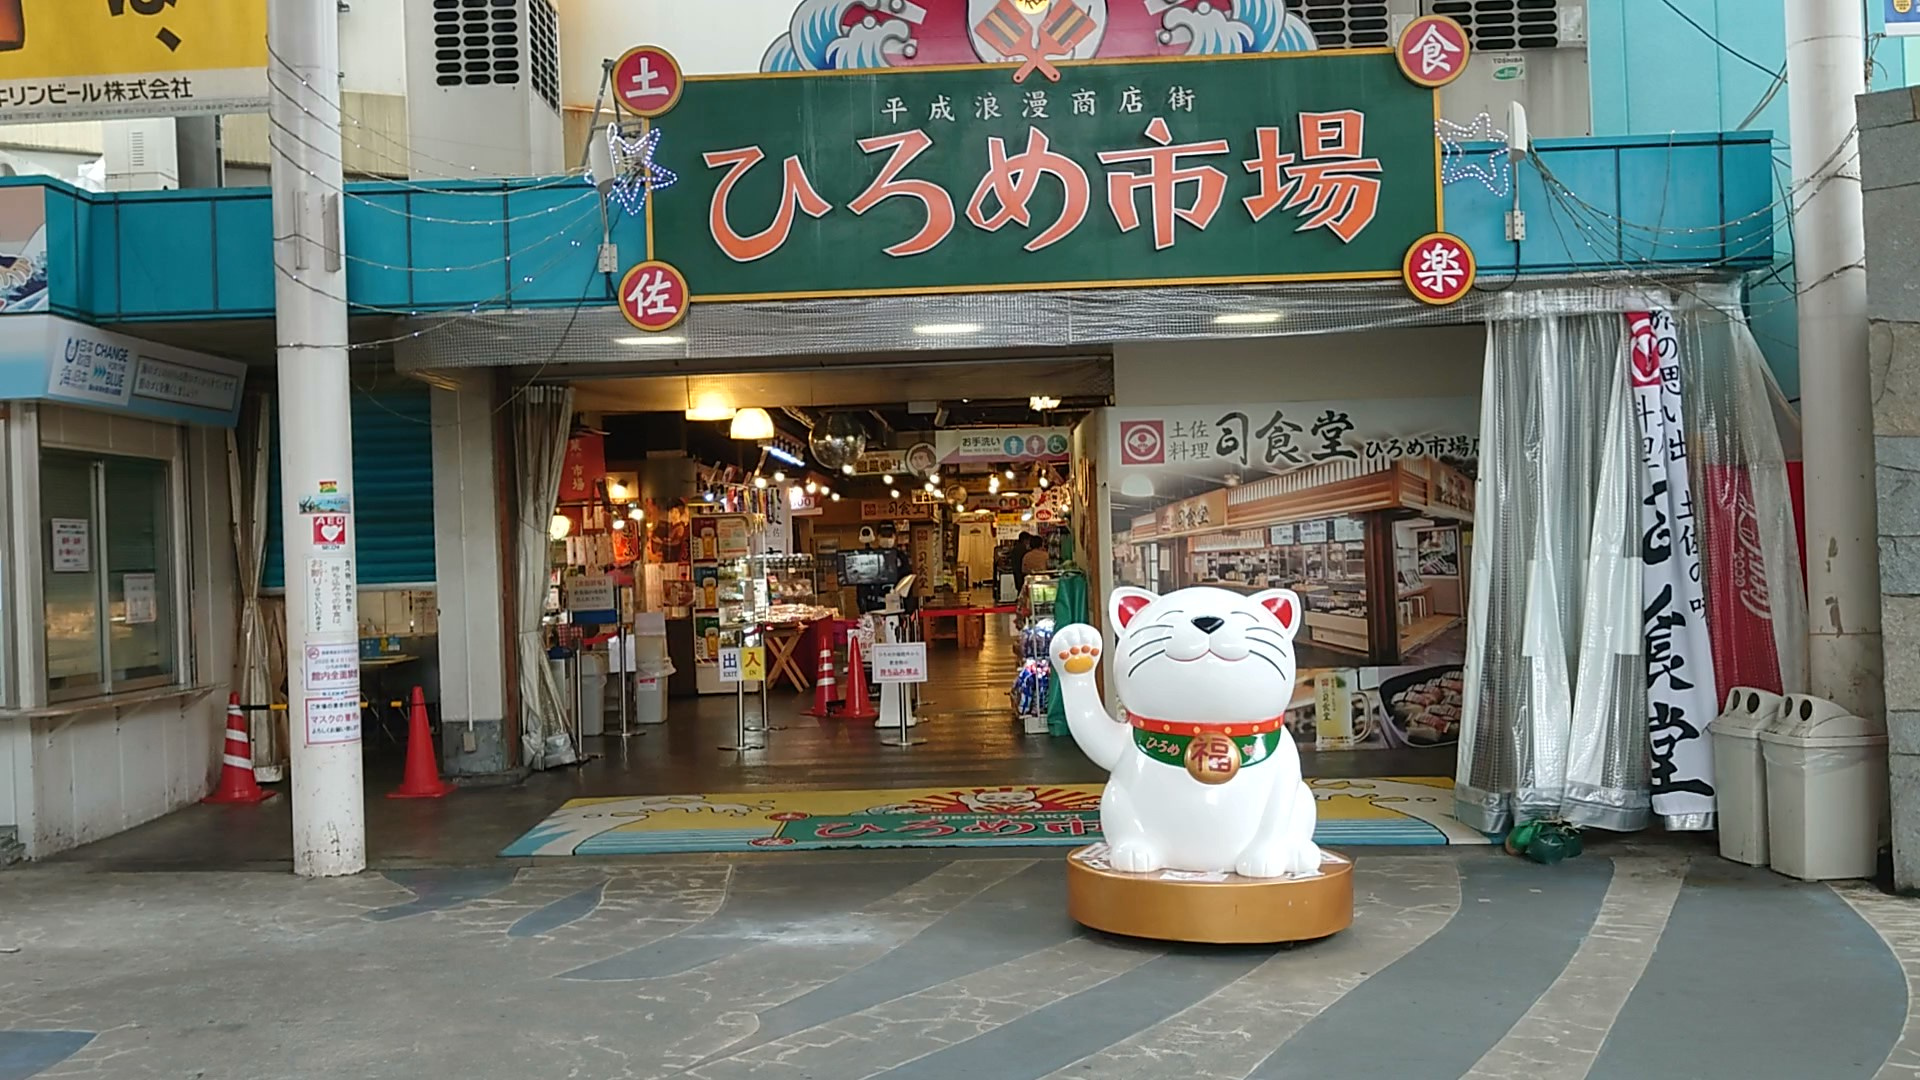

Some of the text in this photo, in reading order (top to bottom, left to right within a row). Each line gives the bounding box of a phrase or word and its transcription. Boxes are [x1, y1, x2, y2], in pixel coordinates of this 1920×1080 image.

[1407, 23, 1461, 75] 食
[625, 57, 670, 99] 土
[881, 85, 1196, 125] 平成浪漫商店街
[702, 109, 1383, 262] ひろめ市場
[1416, 242, 1464, 294] 楽
[626, 270, 678, 318] 佐
[94, 343, 129, 363] CHANGE
[1168, 419, 1210, 439] 土佐
[1215, 410, 1358, 466] 司食堂
[962, 436, 1000, 447] お手洗い
[1168, 441, 1211, 461] 料理
[315, 517, 344, 526] AED
[723, 652, 737, 669] 出
[745, 651, 761, 668] 入
[1146, 737, 1180, 756] ひろめ
[1191, 736, 1232, 772] 福
[1010, 812, 1084, 820] MARKET
